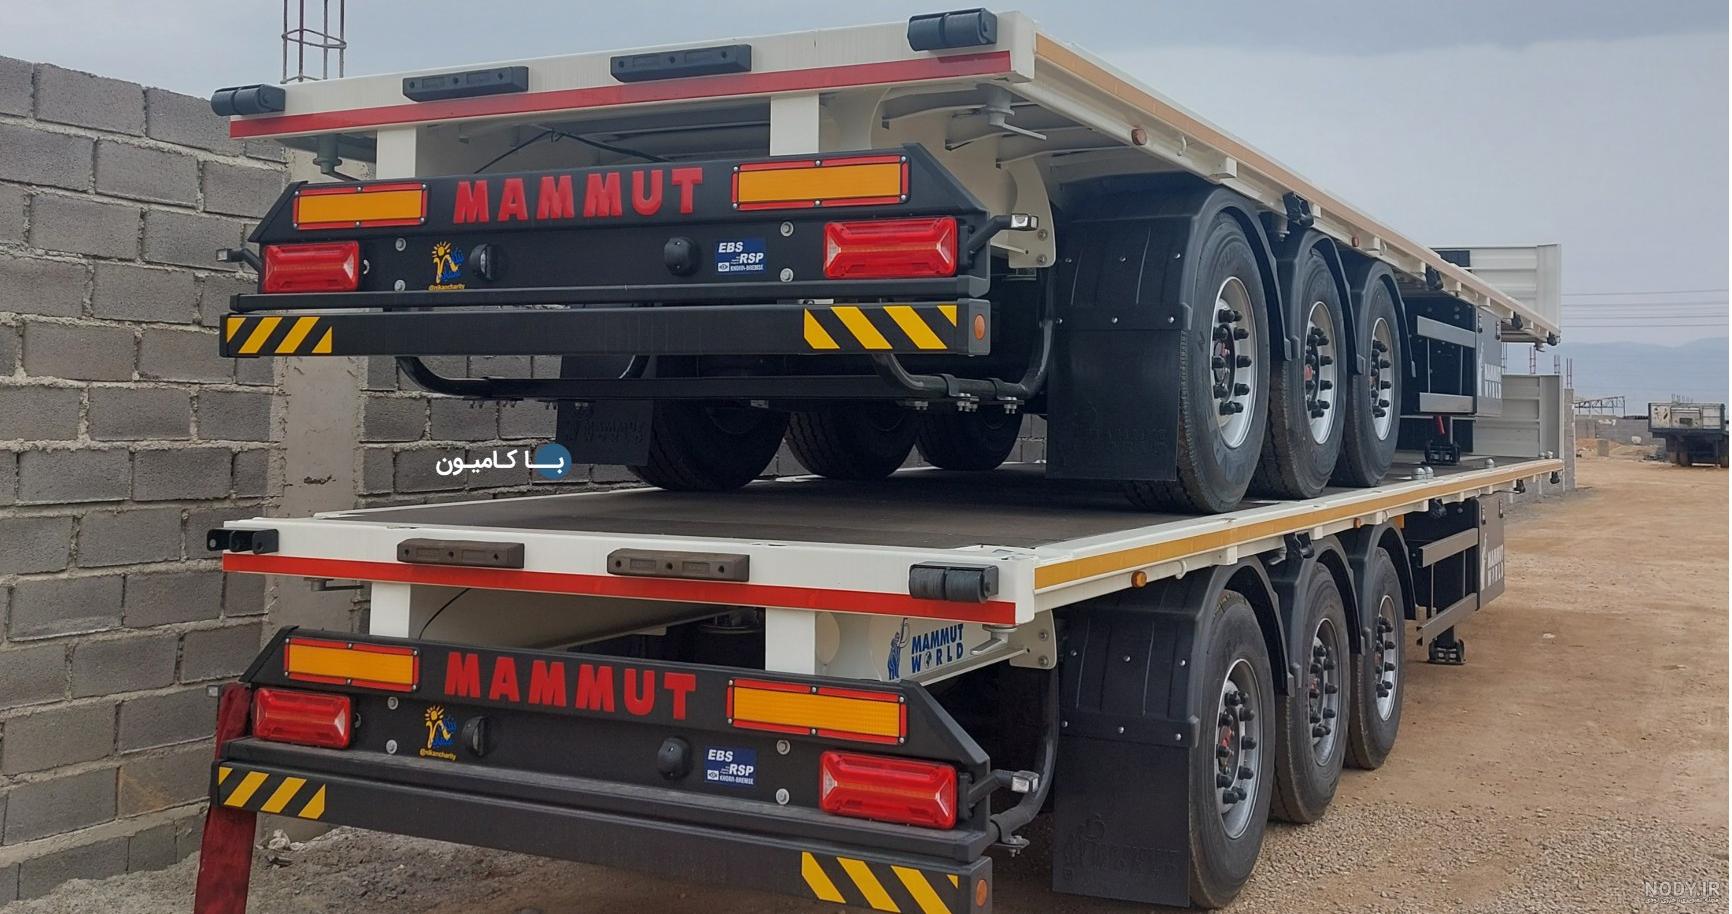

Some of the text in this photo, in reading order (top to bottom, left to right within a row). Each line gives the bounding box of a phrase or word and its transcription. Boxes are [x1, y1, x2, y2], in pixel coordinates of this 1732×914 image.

[453, 167, 703, 224] MAMMUT
[718, 241, 744, 253] EBS
[739, 252, 764, 264] RSP
[911, 623, 964, 655] MAMMUT
[444, 651, 696, 720] MAMMUT
[707, 749, 734, 762] EBS
[728, 763, 754, 776] RSP
